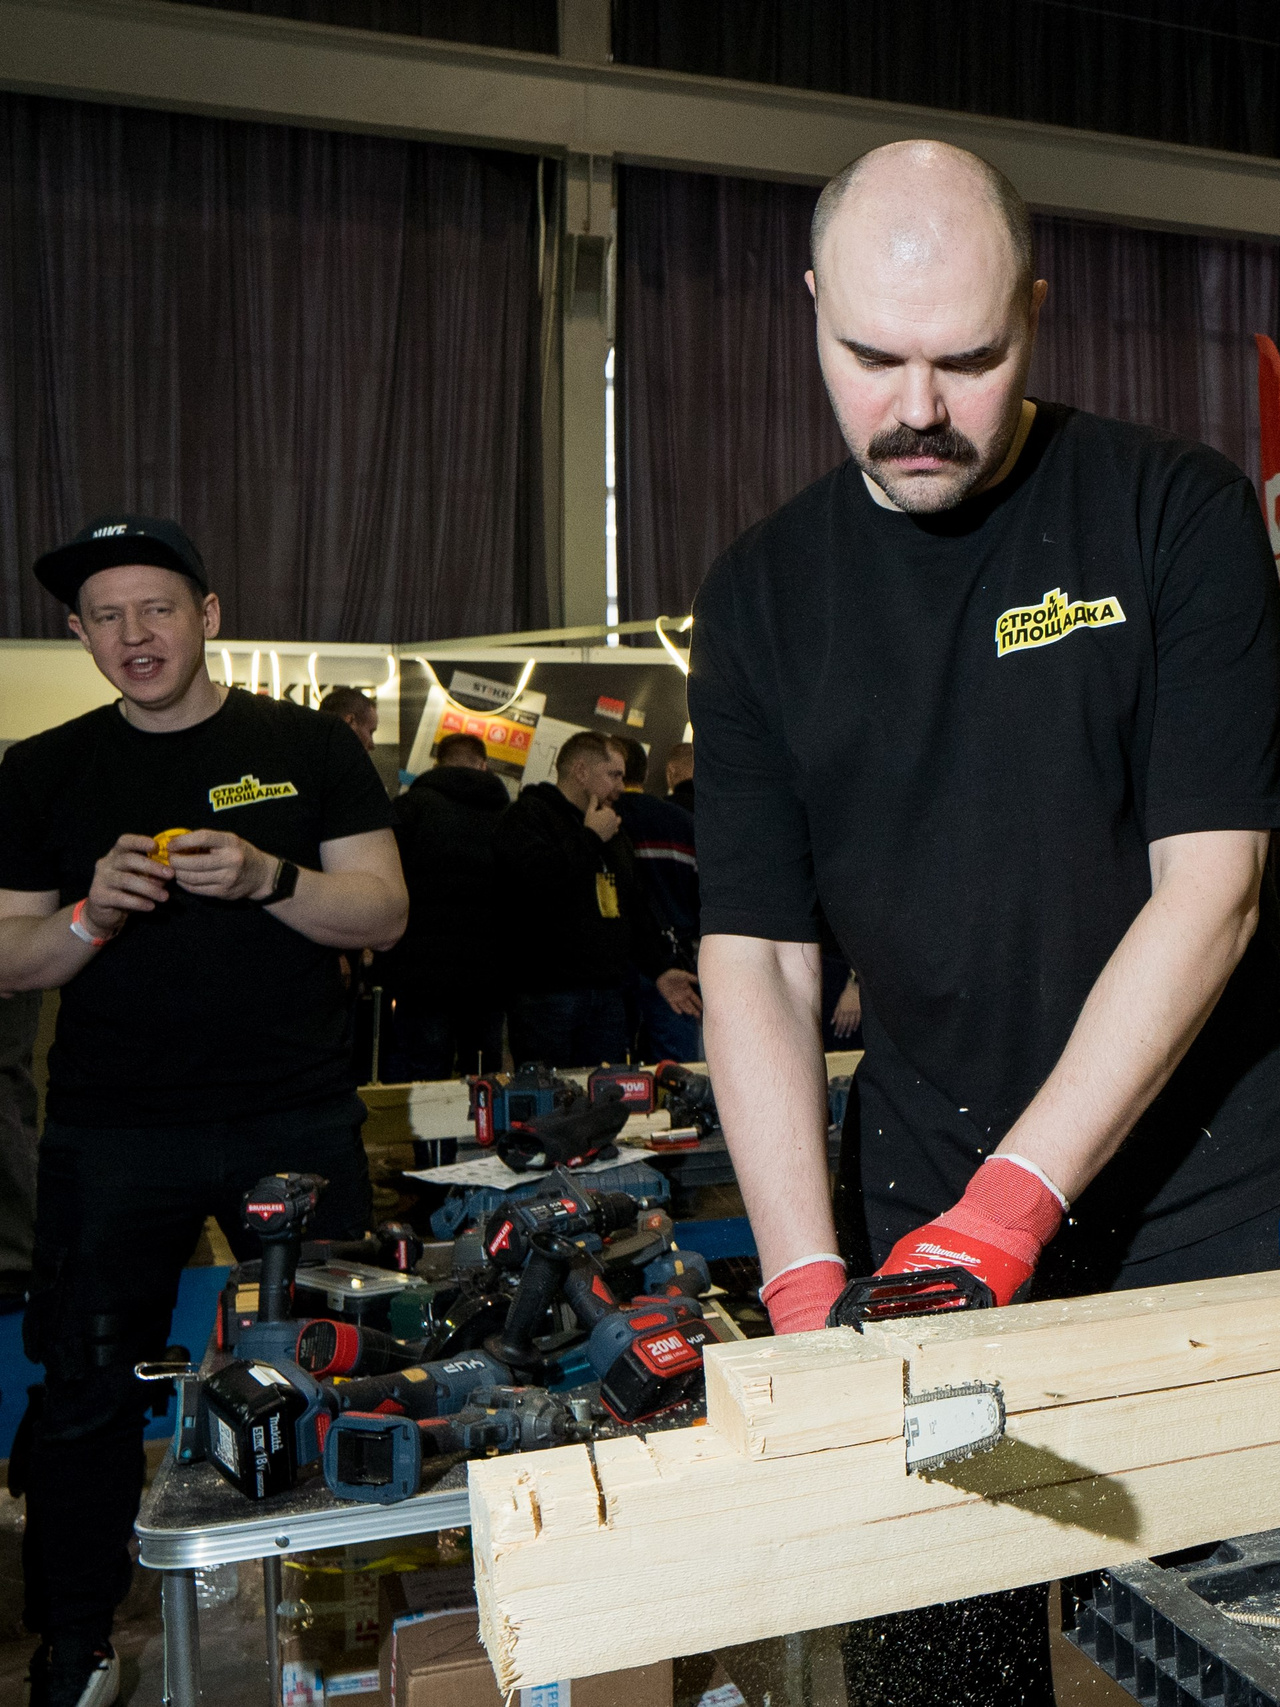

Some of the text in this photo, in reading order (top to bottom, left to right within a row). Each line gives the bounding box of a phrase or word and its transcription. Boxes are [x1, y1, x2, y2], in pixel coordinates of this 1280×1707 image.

[1000, 599, 1064, 633] СТРОЙ-
[1002, 604, 1115, 649] ПЛОЩАДКА
[213, 781, 256, 799] СТРОЙ-
[217, 785, 291, 806] ПЛОЩАДКА
[491, 1223, 511, 1252] BRUSHLESS
[914, 1242, 982, 1264] Milwaukee
[686, 1333, 706, 1345] YUP
[443, 1358, 486, 1374] YUP
[269, 1412, 284, 1454] makita
